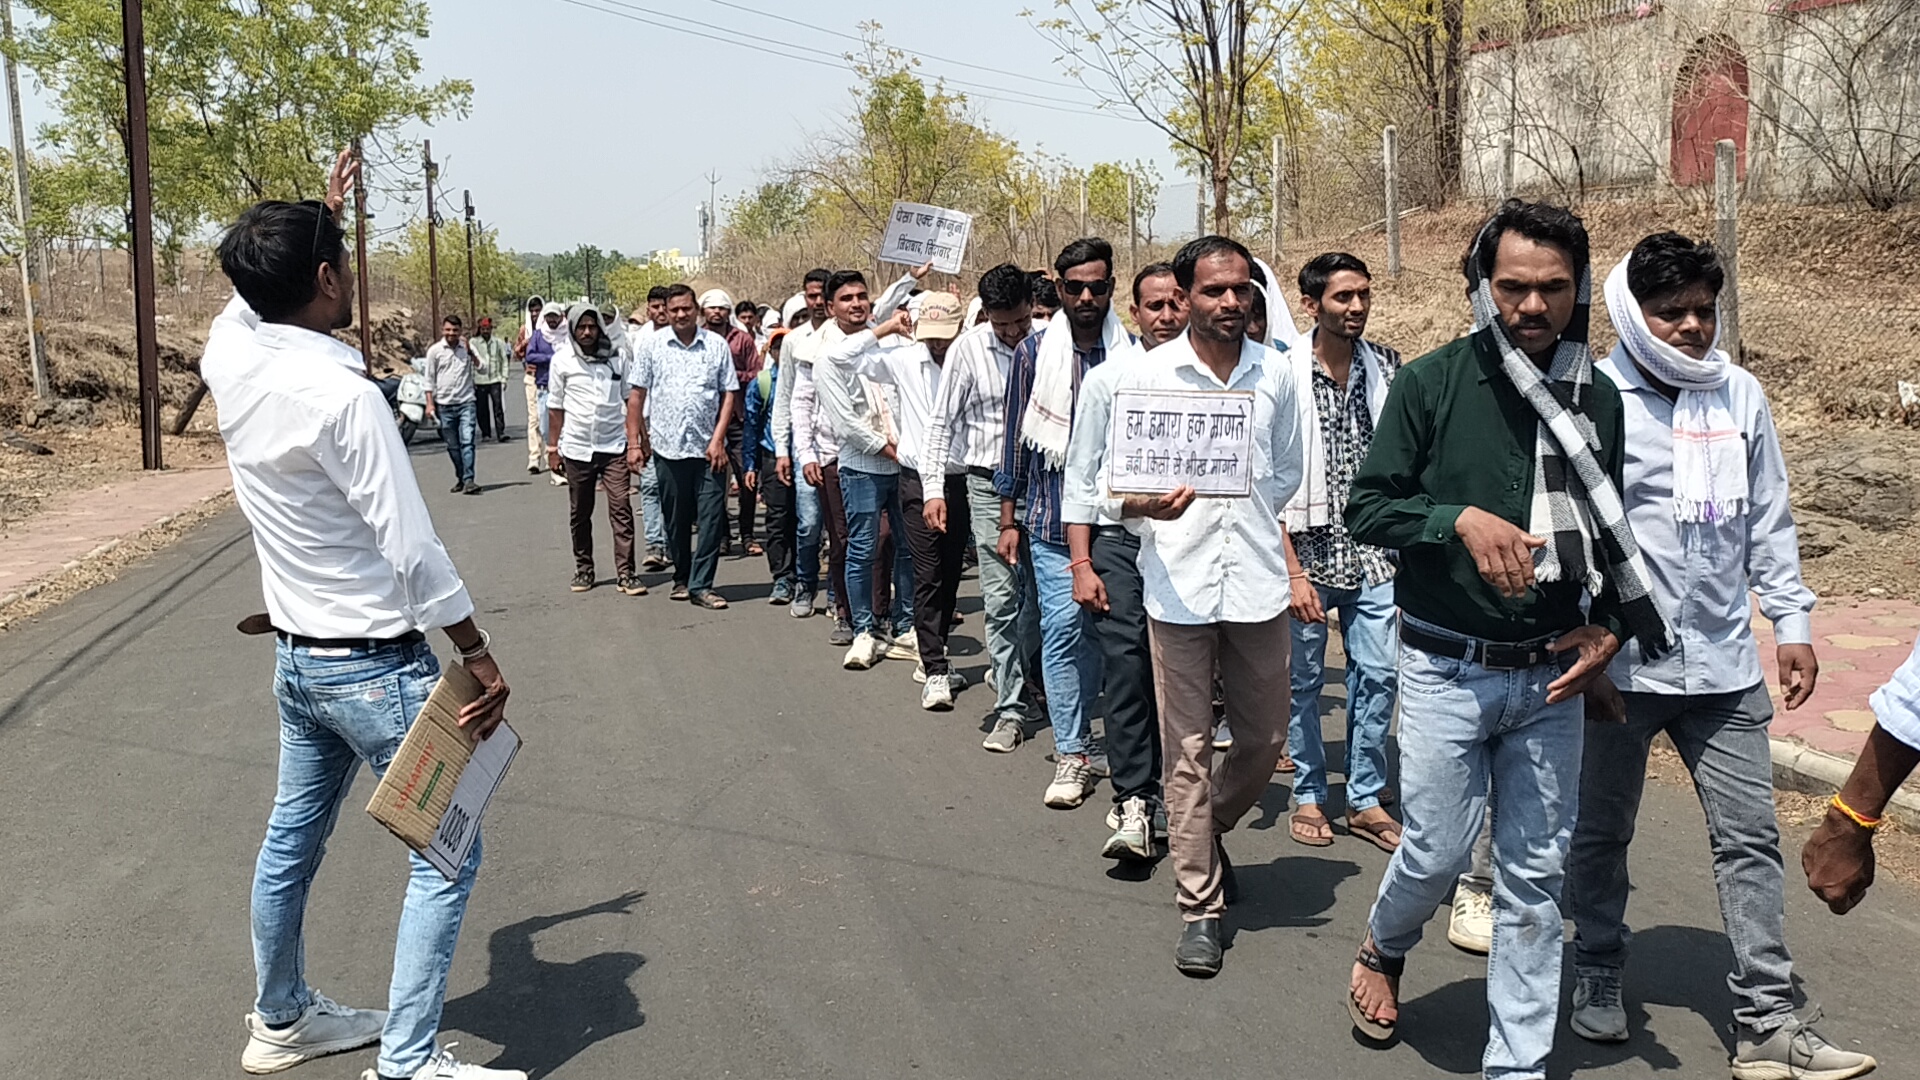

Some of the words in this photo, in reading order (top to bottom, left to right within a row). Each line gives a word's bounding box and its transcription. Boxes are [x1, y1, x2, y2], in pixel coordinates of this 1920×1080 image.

[896, 206, 914, 224] पेसा
[915, 212, 934, 228] एक्ट
[936, 216, 964, 237] कानून
[1126, 410, 1145, 440] हम
[1148, 411, 1183, 441] हमारा
[1187, 413, 1207, 443] हक
[1209, 401, 1247, 441] मांगते
[1146, 448, 1171, 476] किसी
[1173, 451, 1183, 476] से
[1185, 451, 1208, 477] भीख
[1210, 450, 1239, 477] मांगते
